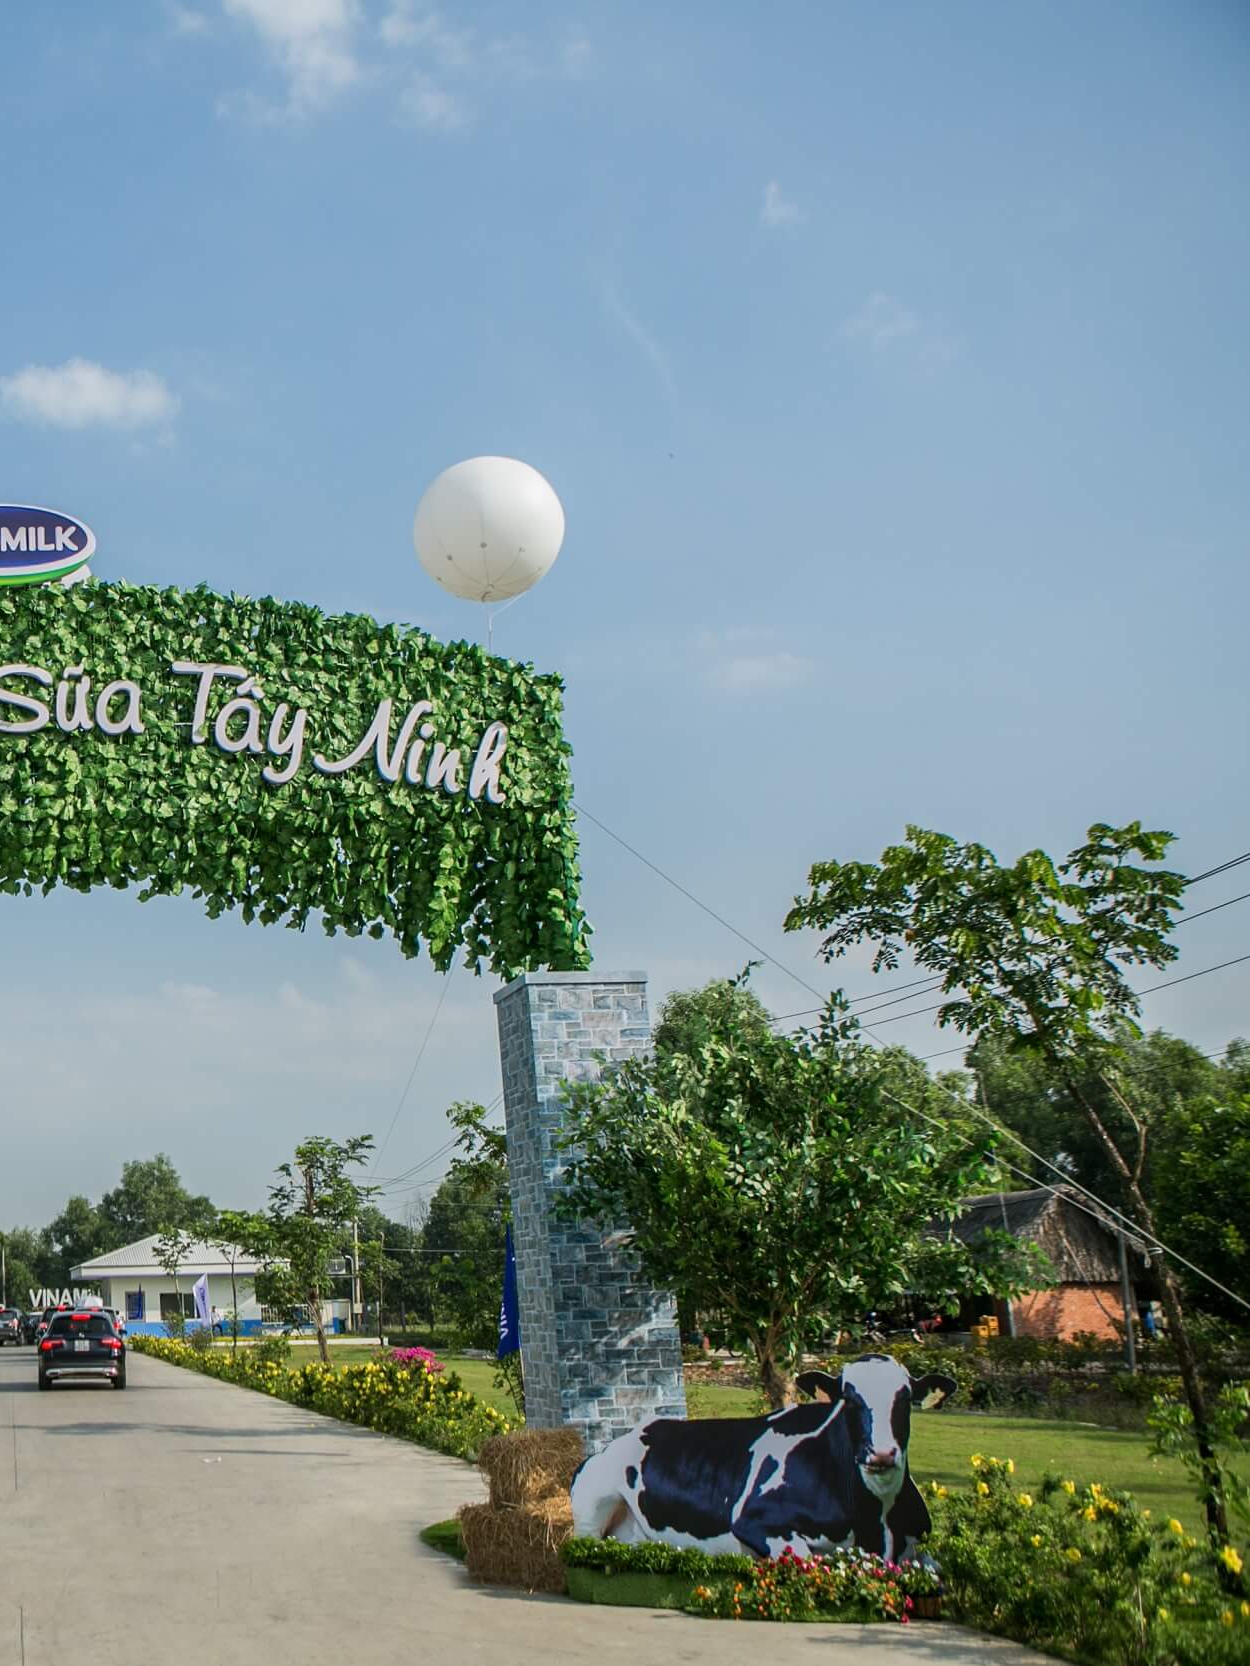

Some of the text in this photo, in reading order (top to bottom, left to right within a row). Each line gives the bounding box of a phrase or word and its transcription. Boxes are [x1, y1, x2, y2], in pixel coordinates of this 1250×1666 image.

[171, 661, 309, 785] Tây
[312, 697, 508, 804] Ninh
[29, 1287, 101, 1308] VINAM
